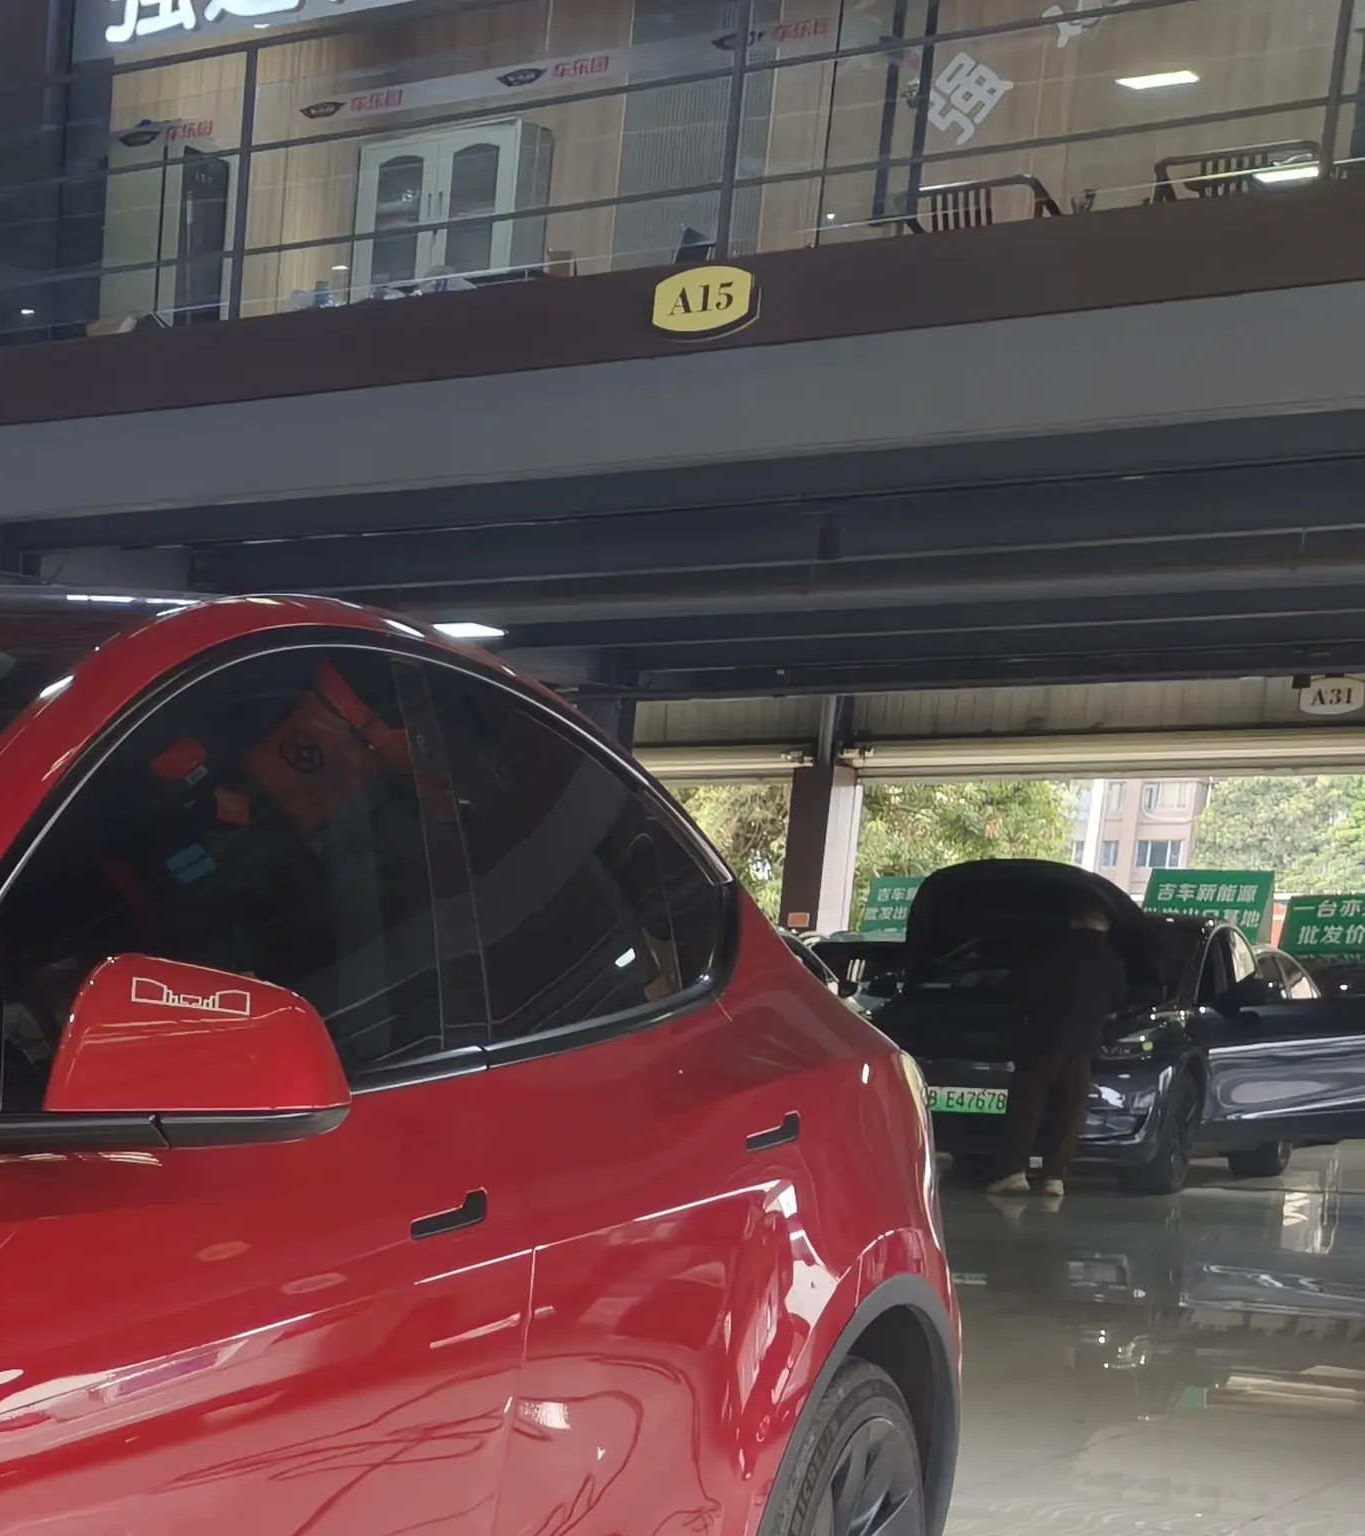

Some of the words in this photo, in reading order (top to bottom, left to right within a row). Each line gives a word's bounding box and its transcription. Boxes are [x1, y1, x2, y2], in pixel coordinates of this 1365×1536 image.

[668, 281, 734, 316] A15
[1310, 687, 1352, 706] A31
[1157, 883, 1258, 902] 吉车新能源
[1293, 900, 1365, 918] 一台亦
[1297, 924, 1365, 945] 批发价
[946, 1091, 1006, 1110] E47678
